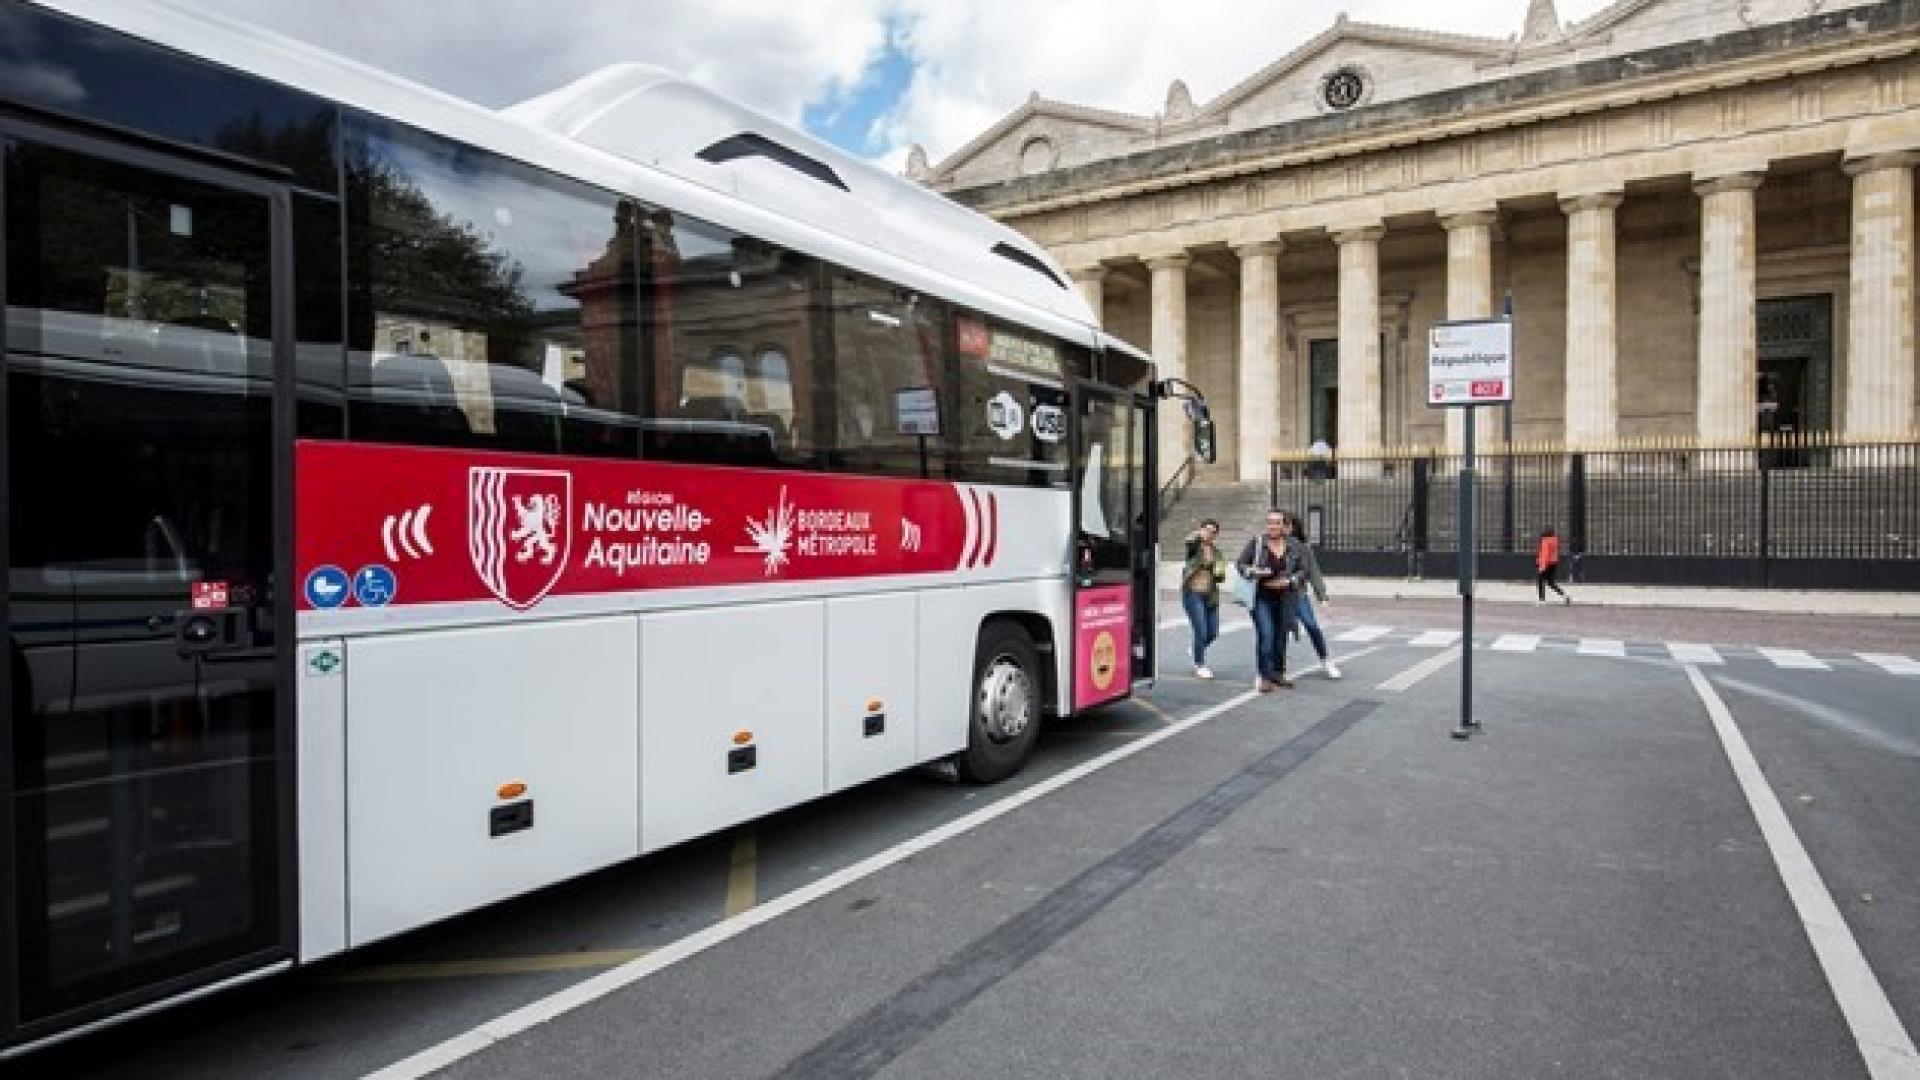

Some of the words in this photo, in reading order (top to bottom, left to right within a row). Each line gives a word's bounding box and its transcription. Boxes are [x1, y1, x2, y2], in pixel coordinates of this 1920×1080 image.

[582, 501, 712, 532] Nouvelle-
[797, 509, 871, 531] BORDEAUX
[583, 535, 711, 577] Aquitaine
[797, 531, 877, 556] MÉTROPOLE
